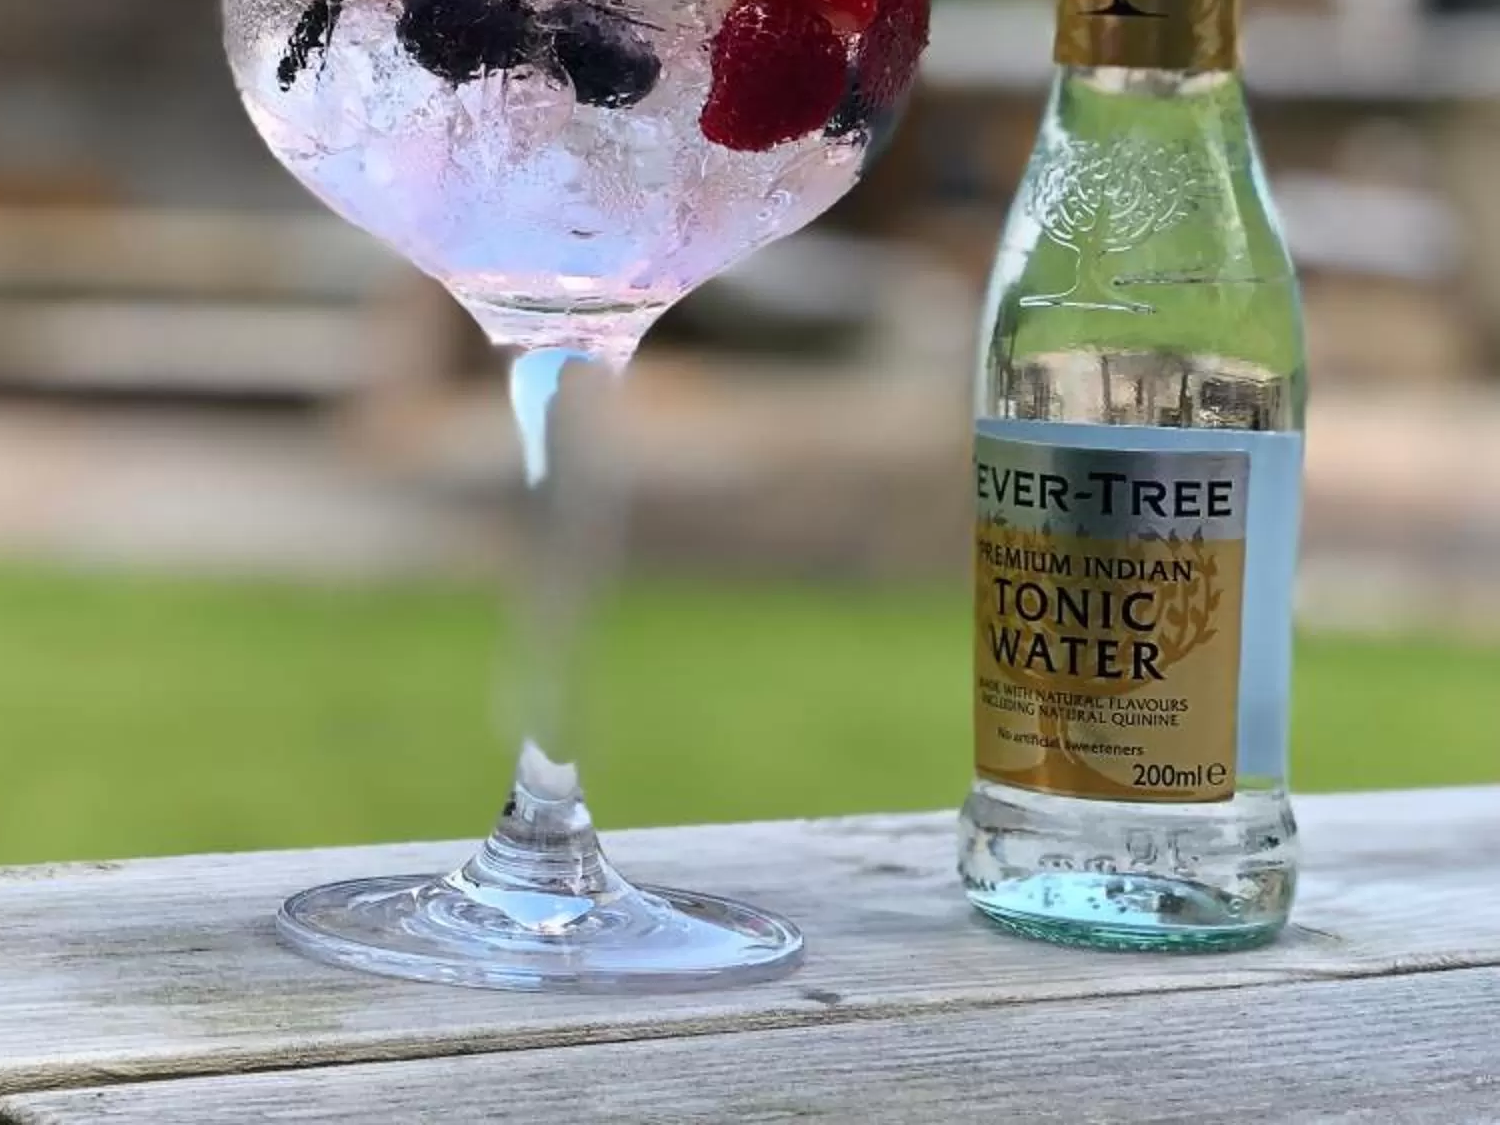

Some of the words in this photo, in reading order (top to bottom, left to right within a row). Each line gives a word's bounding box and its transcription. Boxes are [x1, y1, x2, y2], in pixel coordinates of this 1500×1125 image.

[976, 462, 1232, 517] EVER-TREE
[978, 539, 1072, 576] PREMIUM
[1083, 556, 1192, 582] INDIAN
[994, 577, 1156, 631] TONIC
[990, 625, 1165, 680] WATER
[1036, 689, 1104, 709] NATURAL
[1108, 697, 1189, 712] FLAVOURS
[1039, 704, 1106, 724] NATURAL
[1111, 712, 1180, 727] QUININE
[1132, 763, 1202, 787] 200ml
